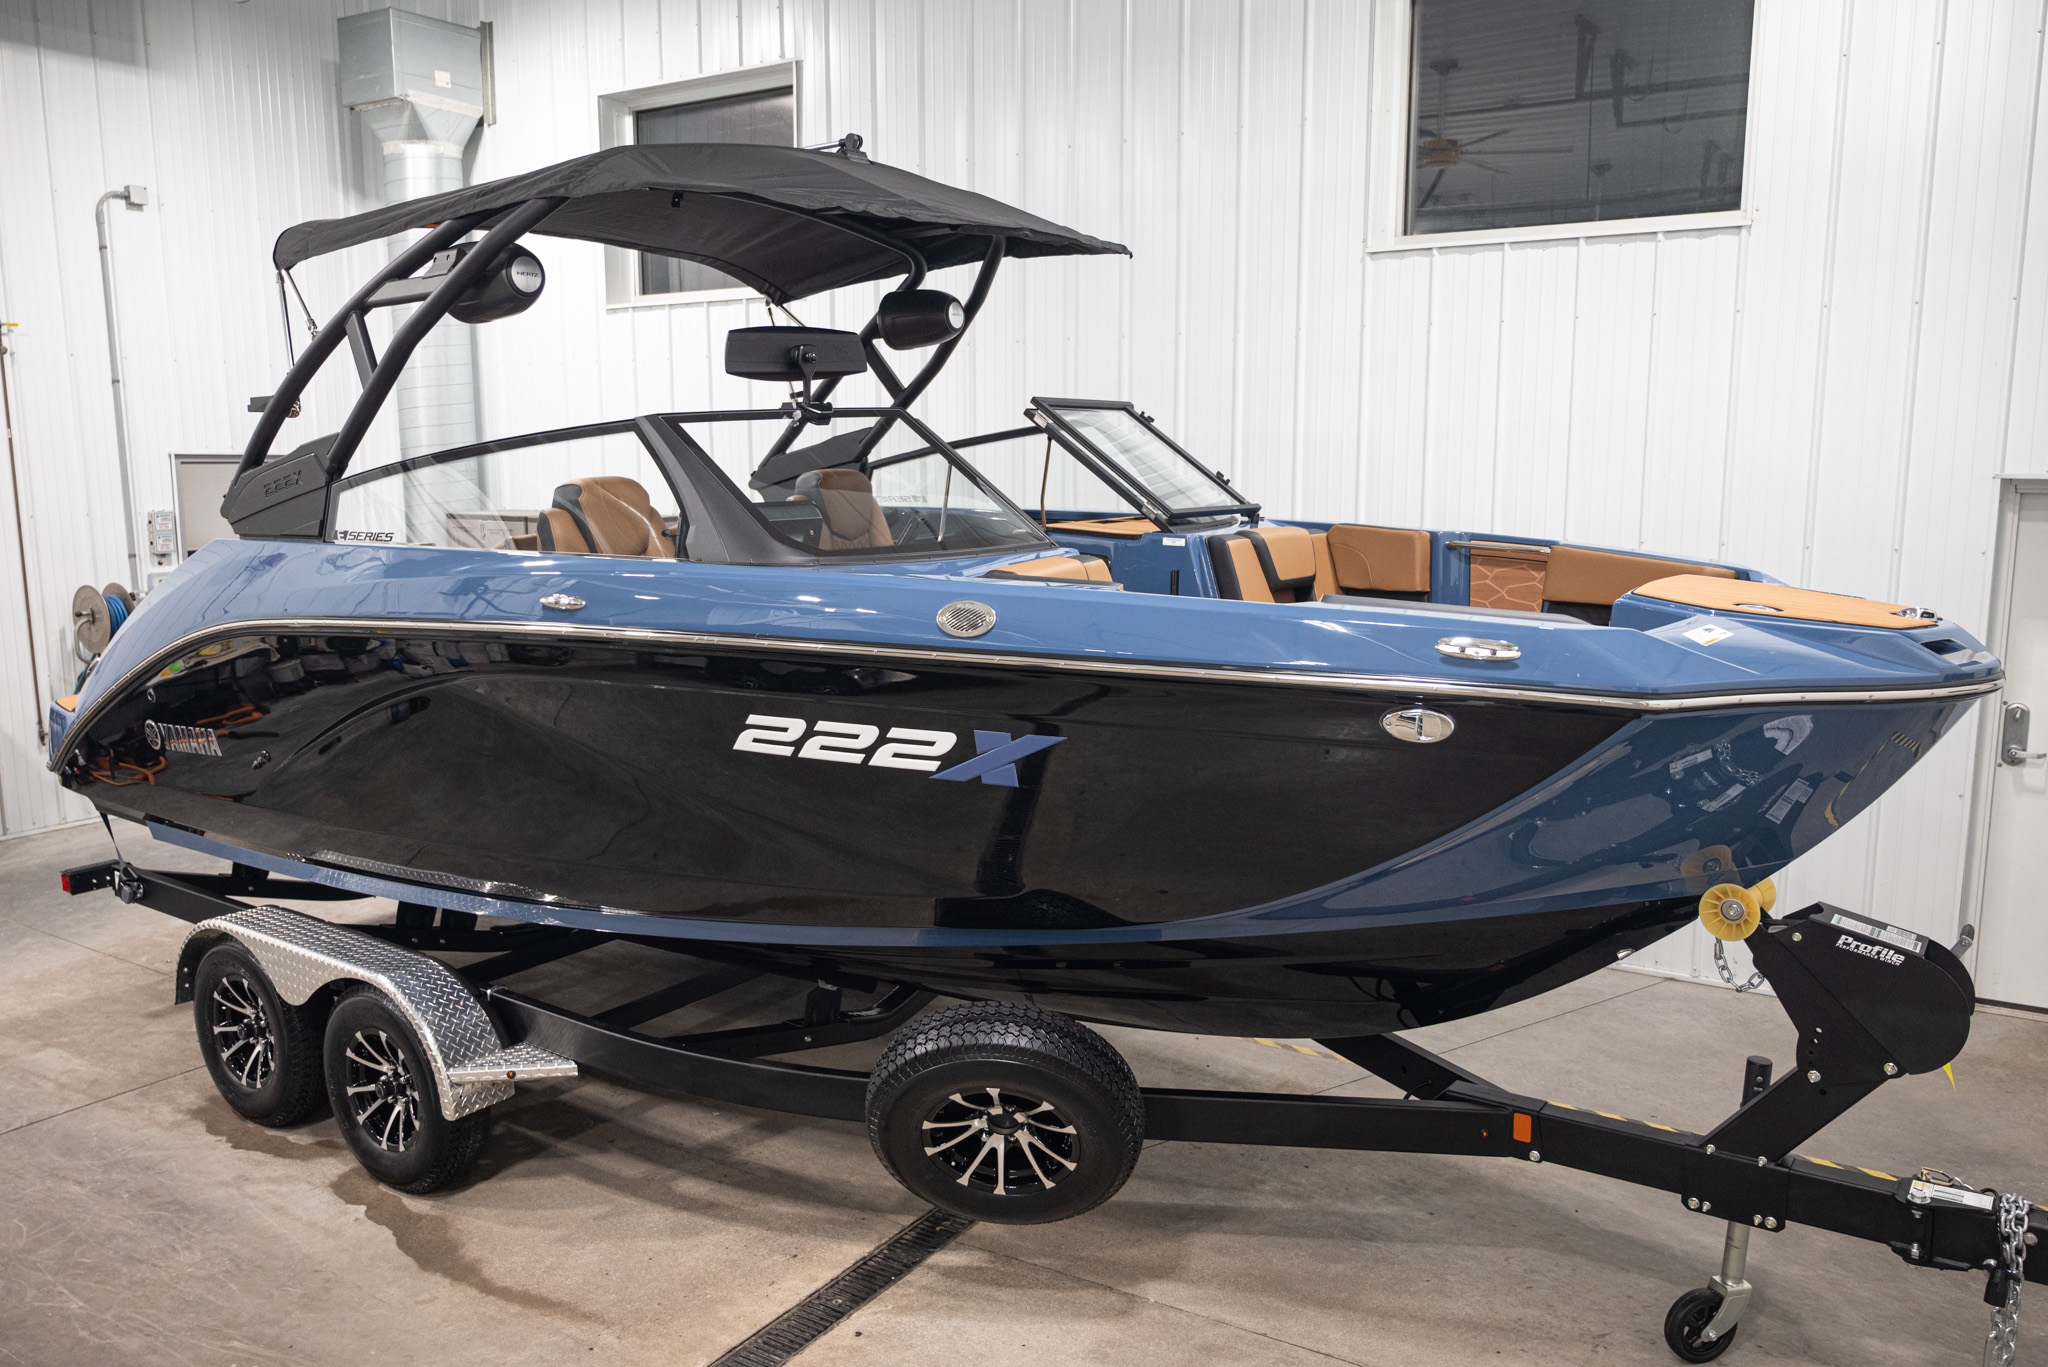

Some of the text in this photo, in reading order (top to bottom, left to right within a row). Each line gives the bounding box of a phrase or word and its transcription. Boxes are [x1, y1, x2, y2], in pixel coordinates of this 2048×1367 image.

[516, 270, 539, 278] HERTZ
[348, 531, 394, 542] SERIES
[157, 722, 223, 757] YAMAHA
[732, 713, 1068, 788] 222X
[1835, 943, 1902, 967] PERFORMANCE WINCH
[1836, 934, 1906, 964] Profile
